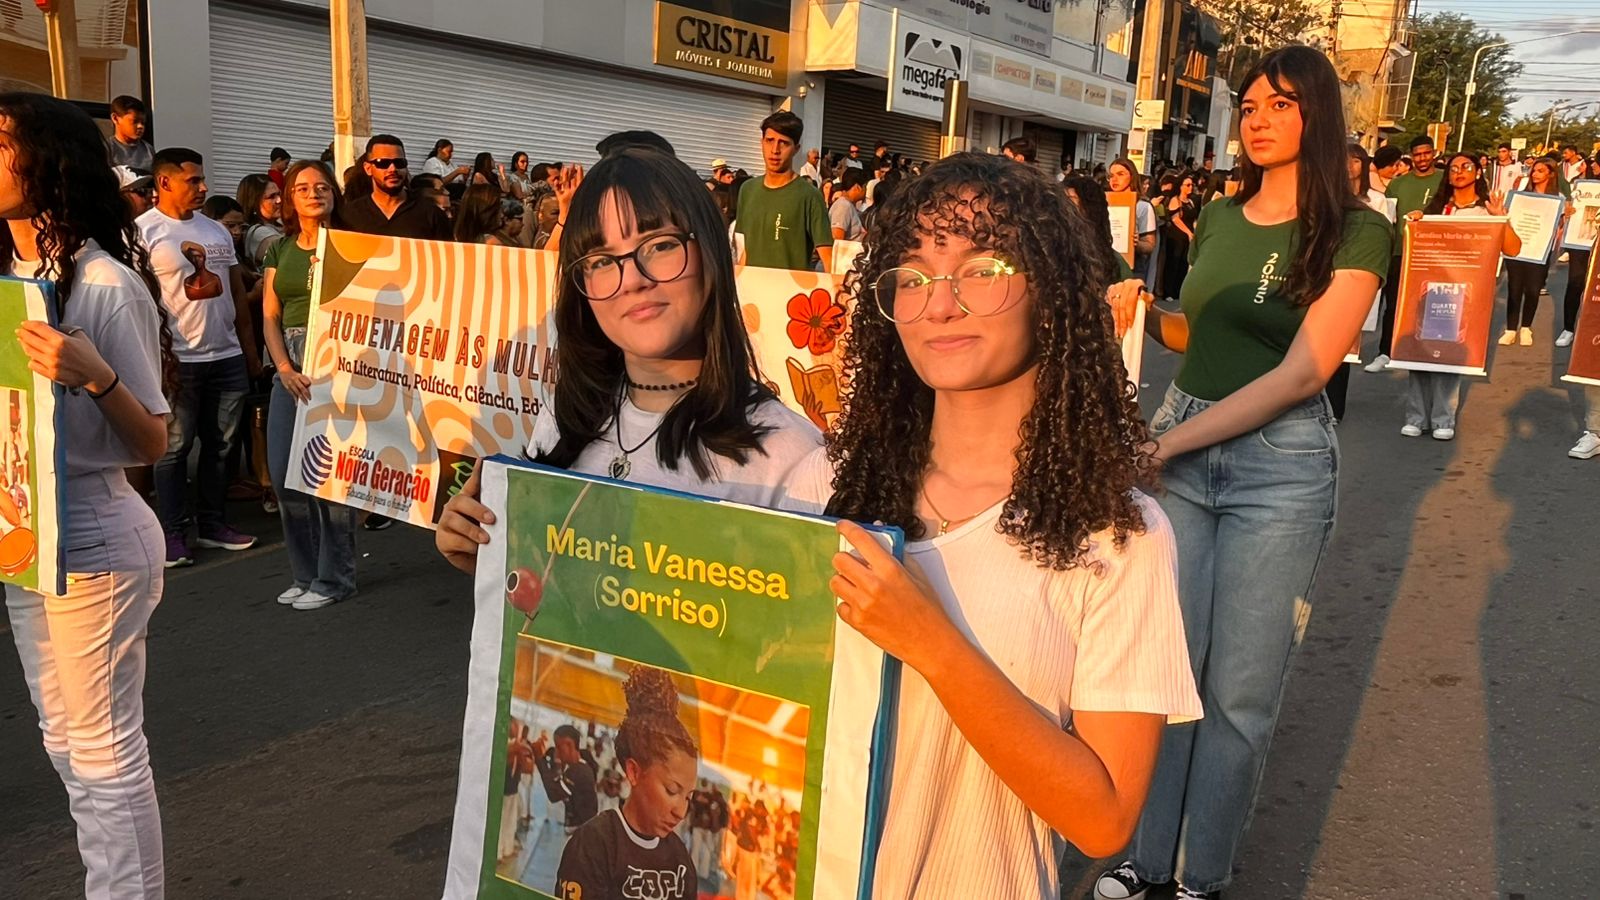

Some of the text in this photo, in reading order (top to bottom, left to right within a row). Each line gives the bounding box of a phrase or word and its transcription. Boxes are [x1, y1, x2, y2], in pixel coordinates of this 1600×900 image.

[675, 49, 713, 66] MÓVEIS
[725, 60, 773, 79] JOALHERIA
[676, 15, 775, 63] CRISTAL
[902, 65, 960, 90] megafá
[329, 309, 449, 361] HOMENAGEM
[456, 326, 486, 368] ÀS
[337, 356, 543, 416] Na Literatura, Política, Ciência, Ed
[335, 450, 430, 504] Nova Geração
[349, 445, 375, 461] ESCOLA
[546, 524, 790, 600] Maria Vanessa
[593, 573, 727, 638] (Sorriso)
